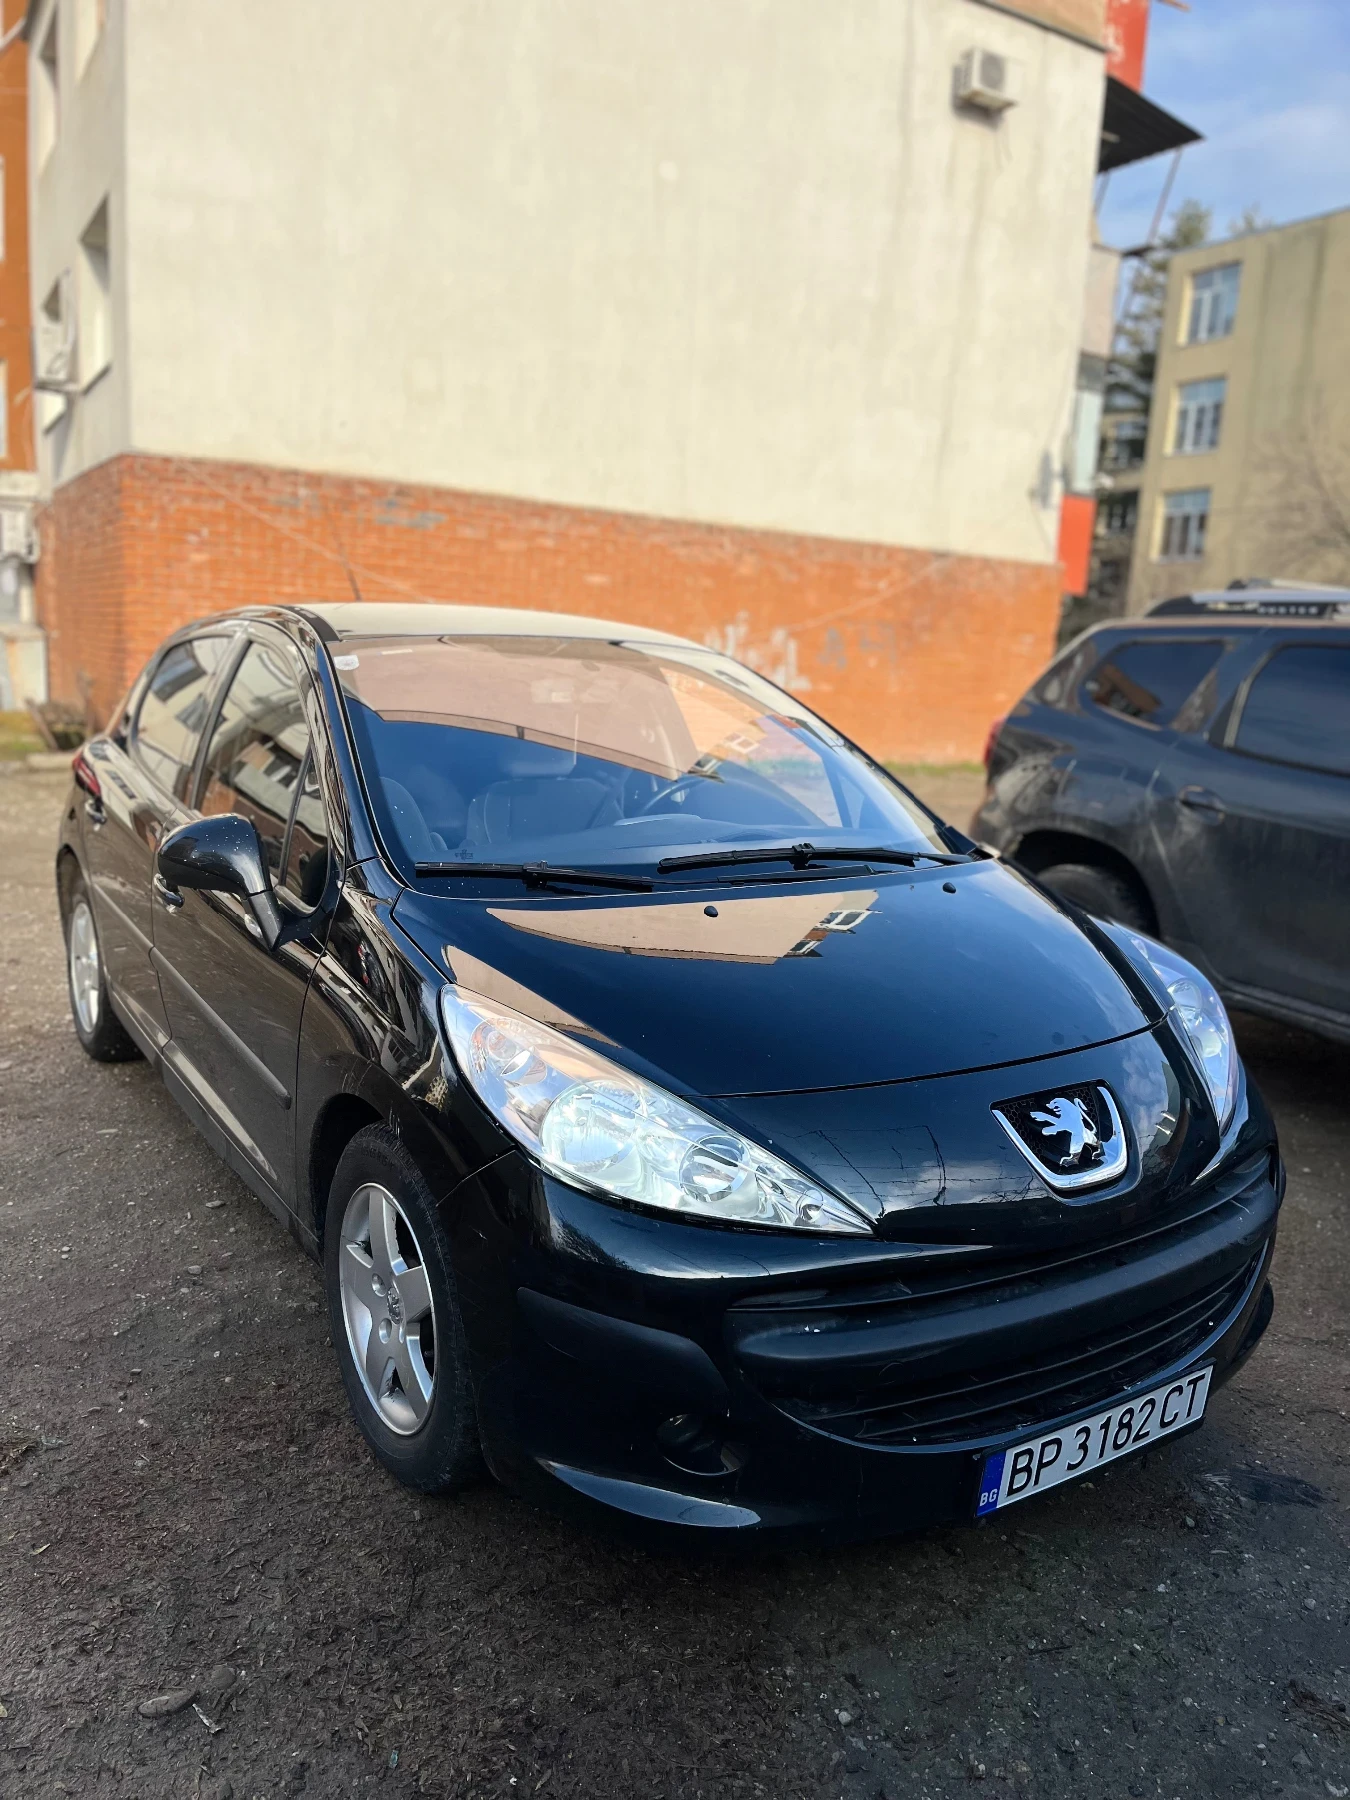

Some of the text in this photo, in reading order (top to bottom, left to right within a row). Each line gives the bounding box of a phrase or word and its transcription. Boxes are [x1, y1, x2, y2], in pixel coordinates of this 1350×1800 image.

[1006, 1372, 1206, 1498] BP 3182 CT
[979, 1488, 998, 1507] BG
